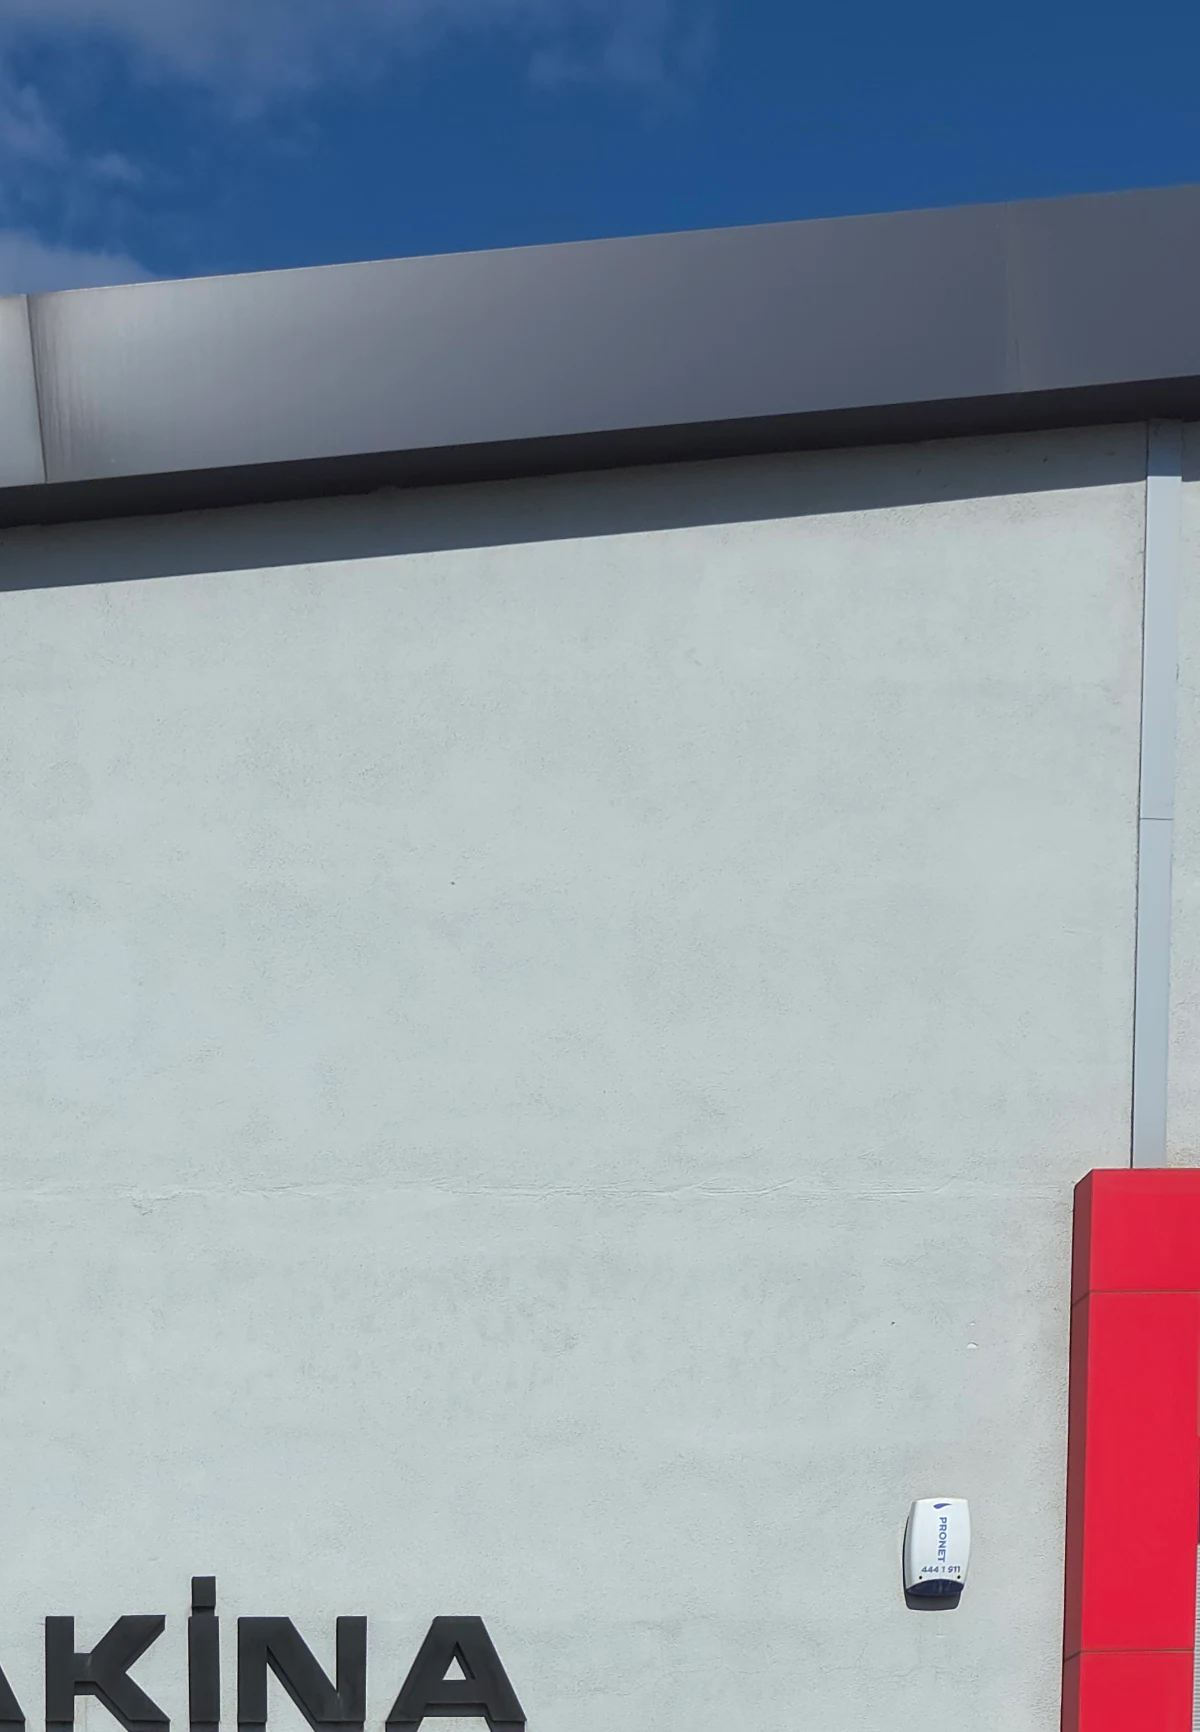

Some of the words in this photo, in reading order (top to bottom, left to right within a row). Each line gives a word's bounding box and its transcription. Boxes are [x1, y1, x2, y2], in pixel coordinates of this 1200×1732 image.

[938, 1517, 947, 1563] PRONET
[921, 1565, 939, 1573] 444
[948, 1565, 961, 1573] 911
